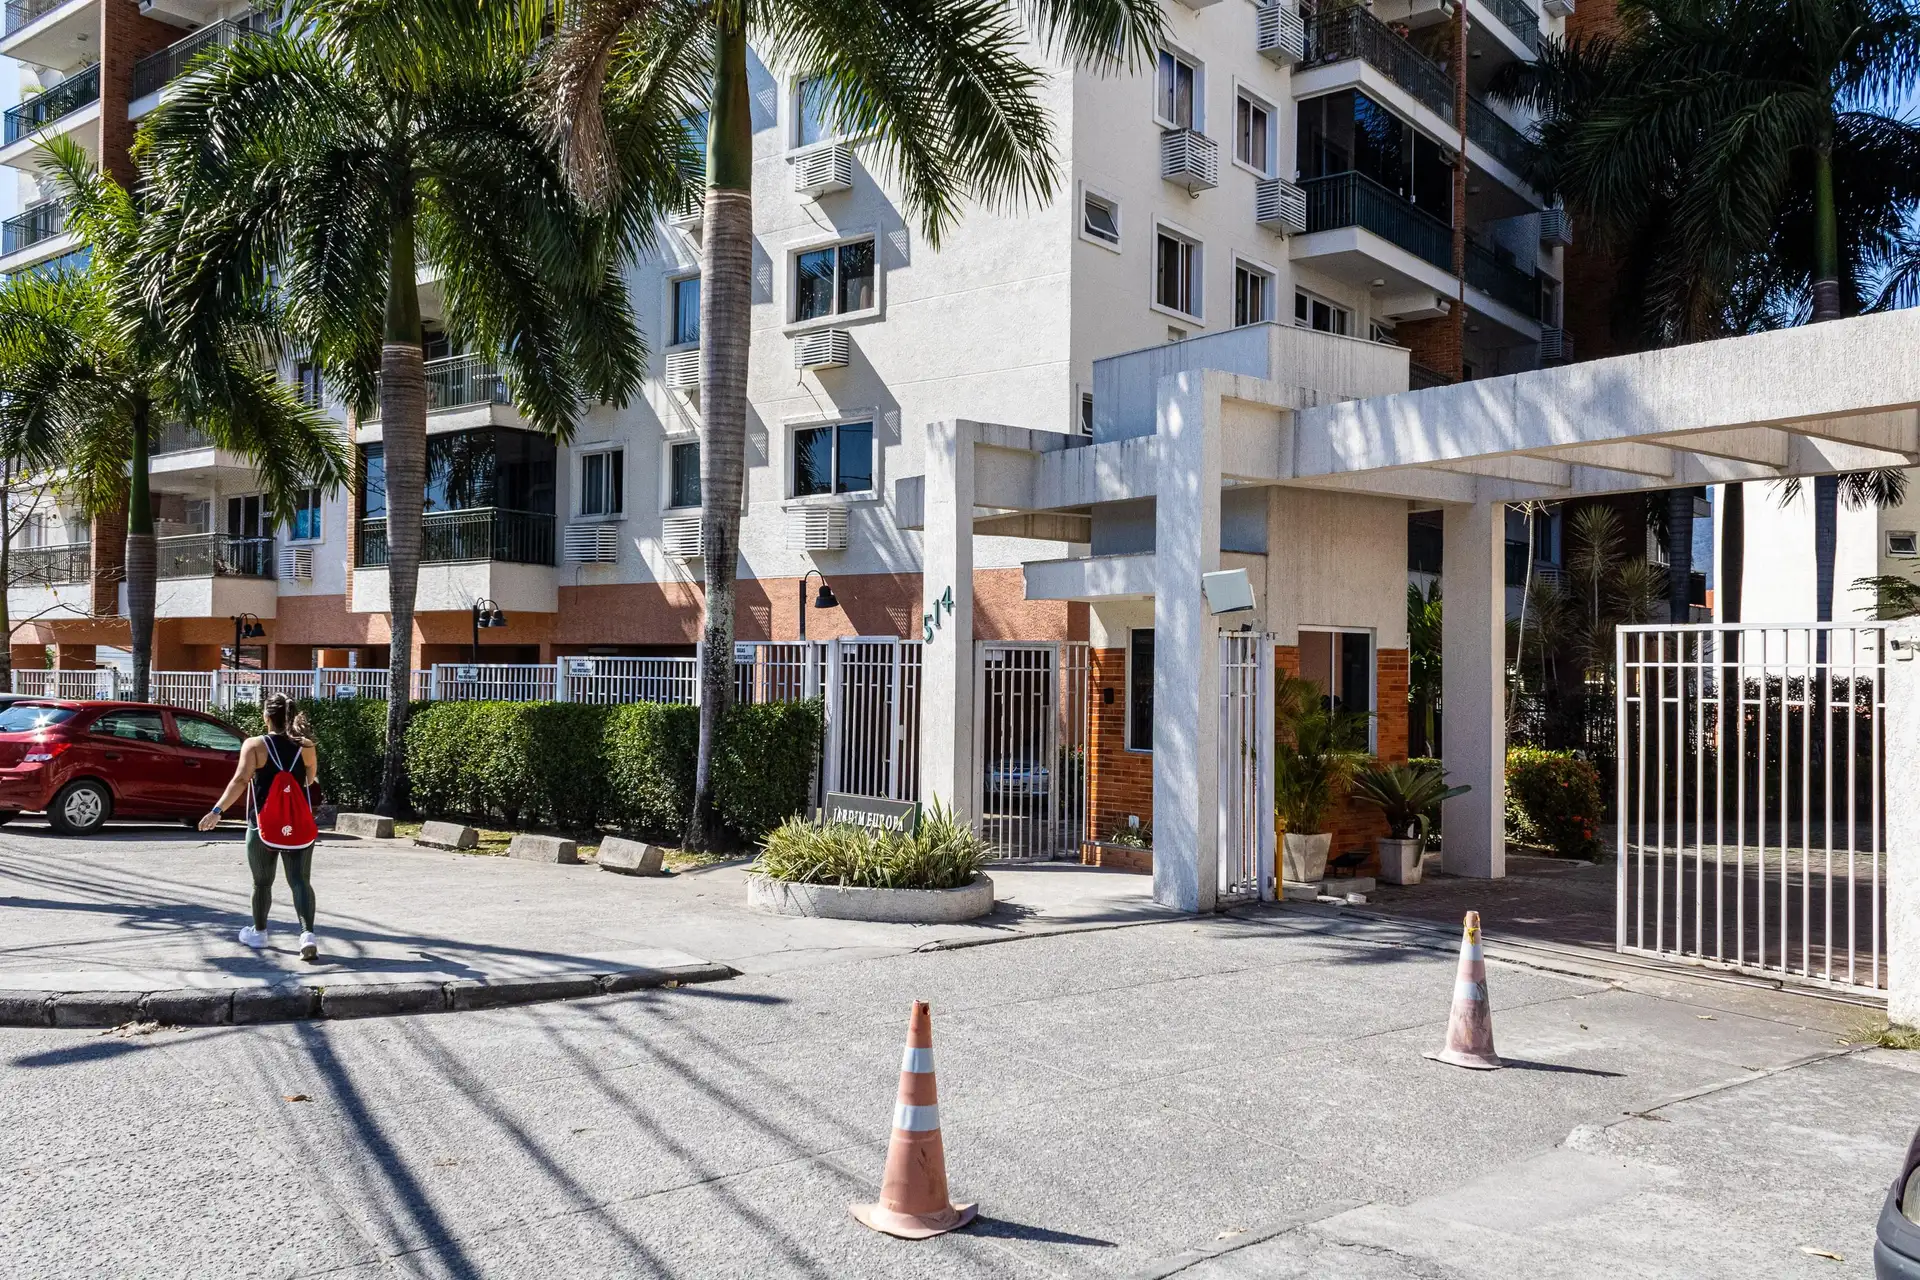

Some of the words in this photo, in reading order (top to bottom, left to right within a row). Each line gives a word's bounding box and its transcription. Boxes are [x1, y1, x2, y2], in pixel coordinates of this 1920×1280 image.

[923, 585, 955, 643] 514
[832, 807, 866, 827] JARDIM
[866, 812, 904, 832] EUROPA
